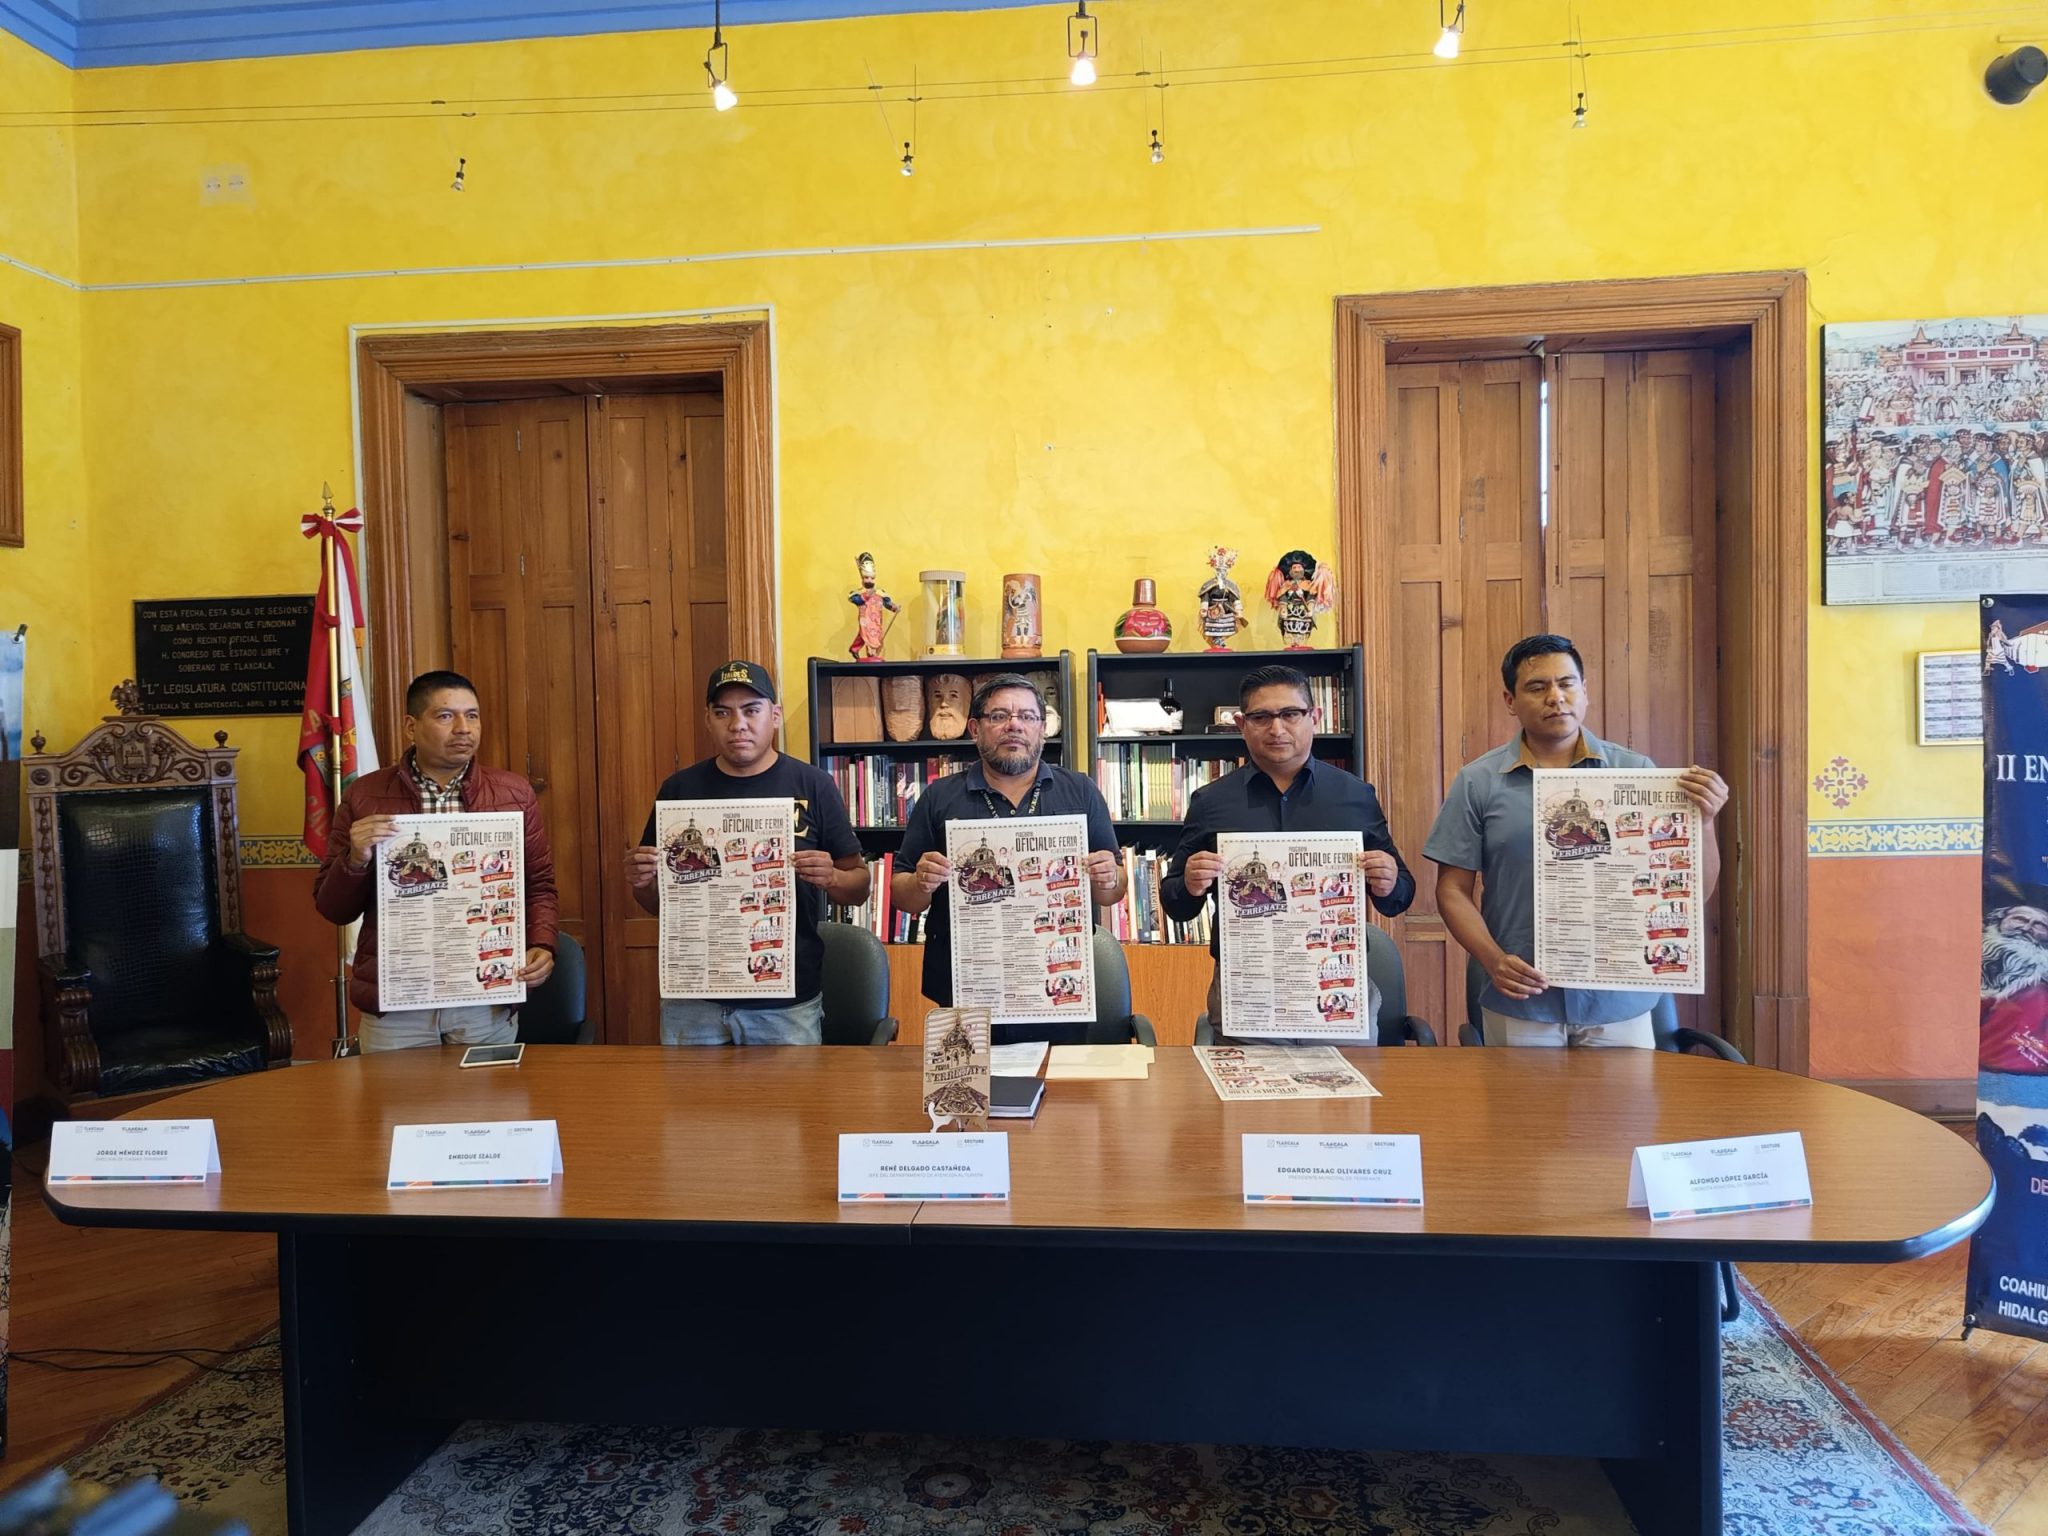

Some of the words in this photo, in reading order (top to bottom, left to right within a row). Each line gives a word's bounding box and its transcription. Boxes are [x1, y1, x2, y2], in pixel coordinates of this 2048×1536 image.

[142, 611, 157, 619] CON
[159, 610, 178, 618] ESTA
[208, 608, 228, 617] ESTA
[231, 608, 250, 616] SALA
[254, 607, 265, 615] DE
[268, 606, 309, 615] SESIONES
[160, 624, 174, 632] SUS
[209, 622, 241, 630] DEJARON
[245, 621, 254, 629] DE
[257, 620, 297, 628] FUNCIONAR
[173, 637, 193, 645] COMO
[196, 636, 227, 645] RECINTO
[230, 635, 259, 643] OFICIAL
[263, 634, 278, 642] DEL
[172, 651, 209, 659] CONGRESO
[212, 650, 226, 658] DEL
[229, 649, 257, 657] ESTADO
[261, 648, 281, 656] LIBRE
[178, 664, 216, 672] SOBERANO
[220, 663, 230, 671] DE
[163, 683, 226, 695] LEGISLATURA
[231, 681, 306, 692] CONSTITUCIONA
[1996, 754, 2017, 782] II
[1614, 790, 1653, 806] OFICIAL
[1652, 791, 1663, 803] DE
[1665, 791, 1688, 803] FERIA
[723, 818, 755, 833] OFICIAL
[755, 819, 763, 829] DE
[765, 818, 783, 829] FERIA
[450, 832, 484, 846] OFICIAL
[484, 832, 492, 842] DE
[495, 831, 513, 842] FERIA
[1015, 837, 1048, 852] OFICIAL
[1048, 837, 1057, 848] DE
[1059, 835, 1077, 847] FERIA
[1552, 845, 1611, 859] TERRENATE
[1288, 852, 1323, 867] OFICIAL
[1322, 852, 1331, 864] DE
[1333, 852, 1353, 864] FERIA
[673, 869, 722, 883] TERRENATE
[395, 882, 448, 897] TERRENATE
[965, 889, 1016, 904] TERRENATE
[1236, 903, 1288, 918] TERRENATE
[880, 1164, 897, 1172] RENÉ
[931, 1164, 971, 1172] CASTAÑEDA
[1690, 1176, 1720, 1185] ALFONSO
[1721, 1174, 1742, 1183] LÓPEZ
[1743, 1172, 1769, 1181] GARCÍA
[1998, 1300, 2048, 1325] HIDALG
